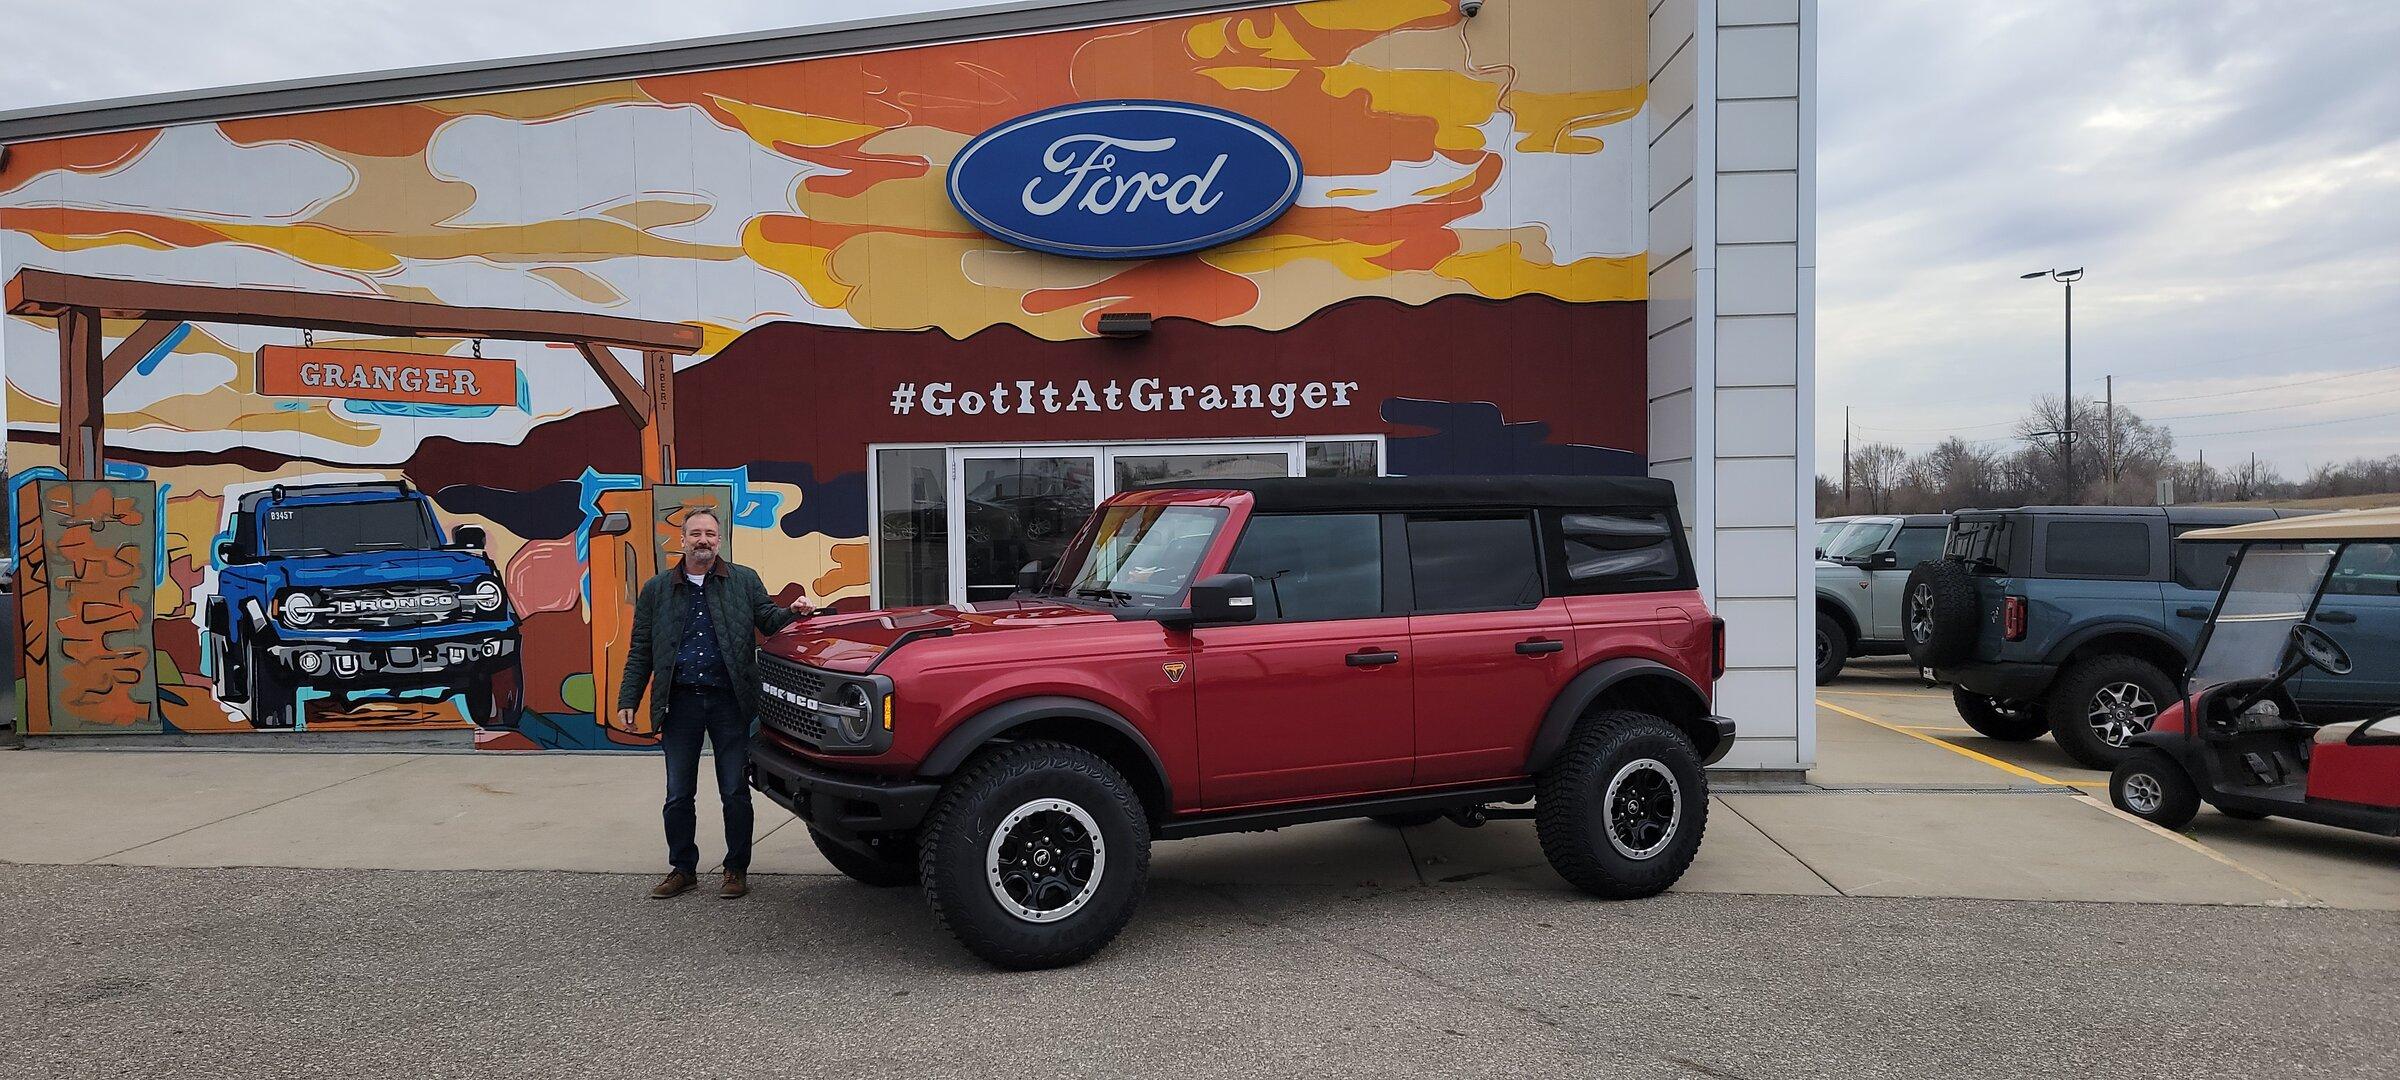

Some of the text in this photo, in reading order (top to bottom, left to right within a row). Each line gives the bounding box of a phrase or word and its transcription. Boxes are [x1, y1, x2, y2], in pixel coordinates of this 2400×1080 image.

[1022, 134, 1228, 215] Ford
[300, 363, 481, 396] GRANGER
[659, 355, 667, 410] ALBERT
[889, 378, 1359, 418] #GotItAtGranger
[341, 594, 452, 613] BRONCO
